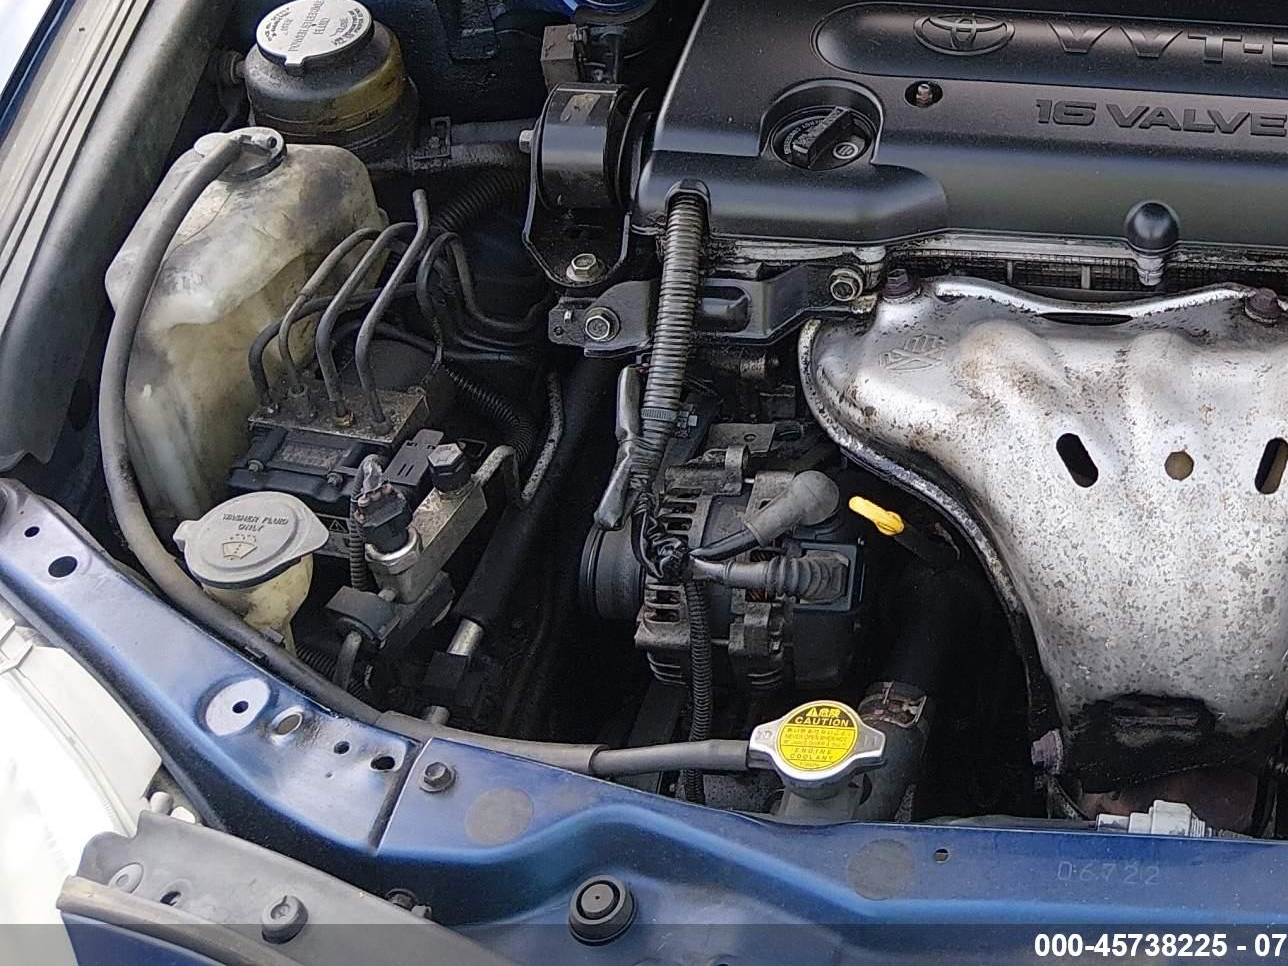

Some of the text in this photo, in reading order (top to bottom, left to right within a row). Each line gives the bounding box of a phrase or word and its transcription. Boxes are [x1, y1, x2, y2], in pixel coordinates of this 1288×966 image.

[1035, 98, 1288, 136] 16 VALVE
[223, 514, 289, 525] WASHER FLUID
[795, 716, 850, 727] CAUTION
[795, 747, 832, 755] ENGINE
